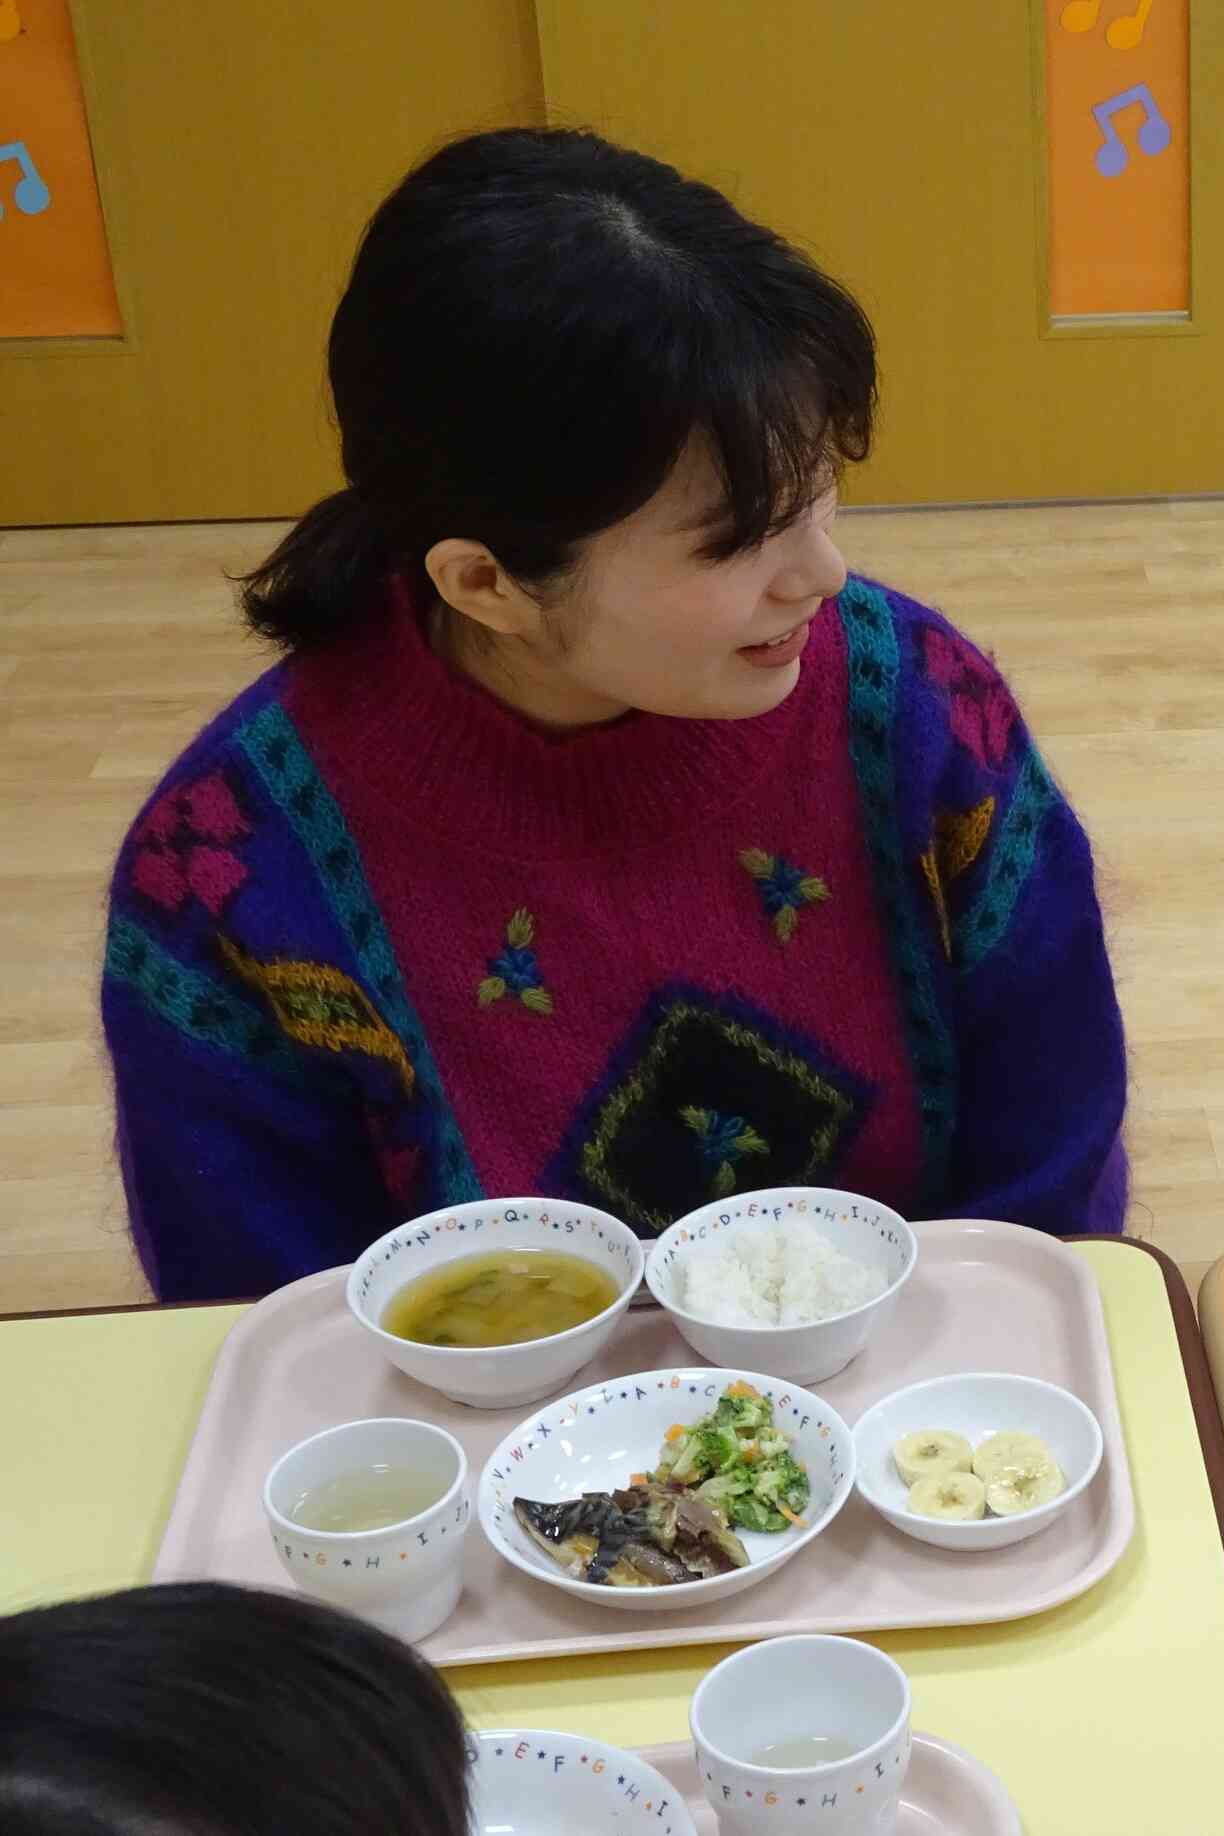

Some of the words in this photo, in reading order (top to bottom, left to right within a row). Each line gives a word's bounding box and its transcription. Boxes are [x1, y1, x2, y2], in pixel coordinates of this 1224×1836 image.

[504, 1210, 519, 1222] Q
[565, 1221, 574, 1232] S
[720, 1214, 730, 1225] D
[748, 1204, 758, 1217] E
[773, 1208, 782, 1221] F
[851, 1206, 859, 1218] I
[537, 1424, 551, 1438] X
[705, 1385, 715, 1397] C
[800, 1416, 809, 1429] F
[366, 1557, 379, 1568] H
[514, 1742, 529, 1759] E
[554, 1756, 564, 1773] F
[592, 1758, 605, 1774] G
[624, 1784, 640, 1800] H
[822, 1793, 837, 1807] H
